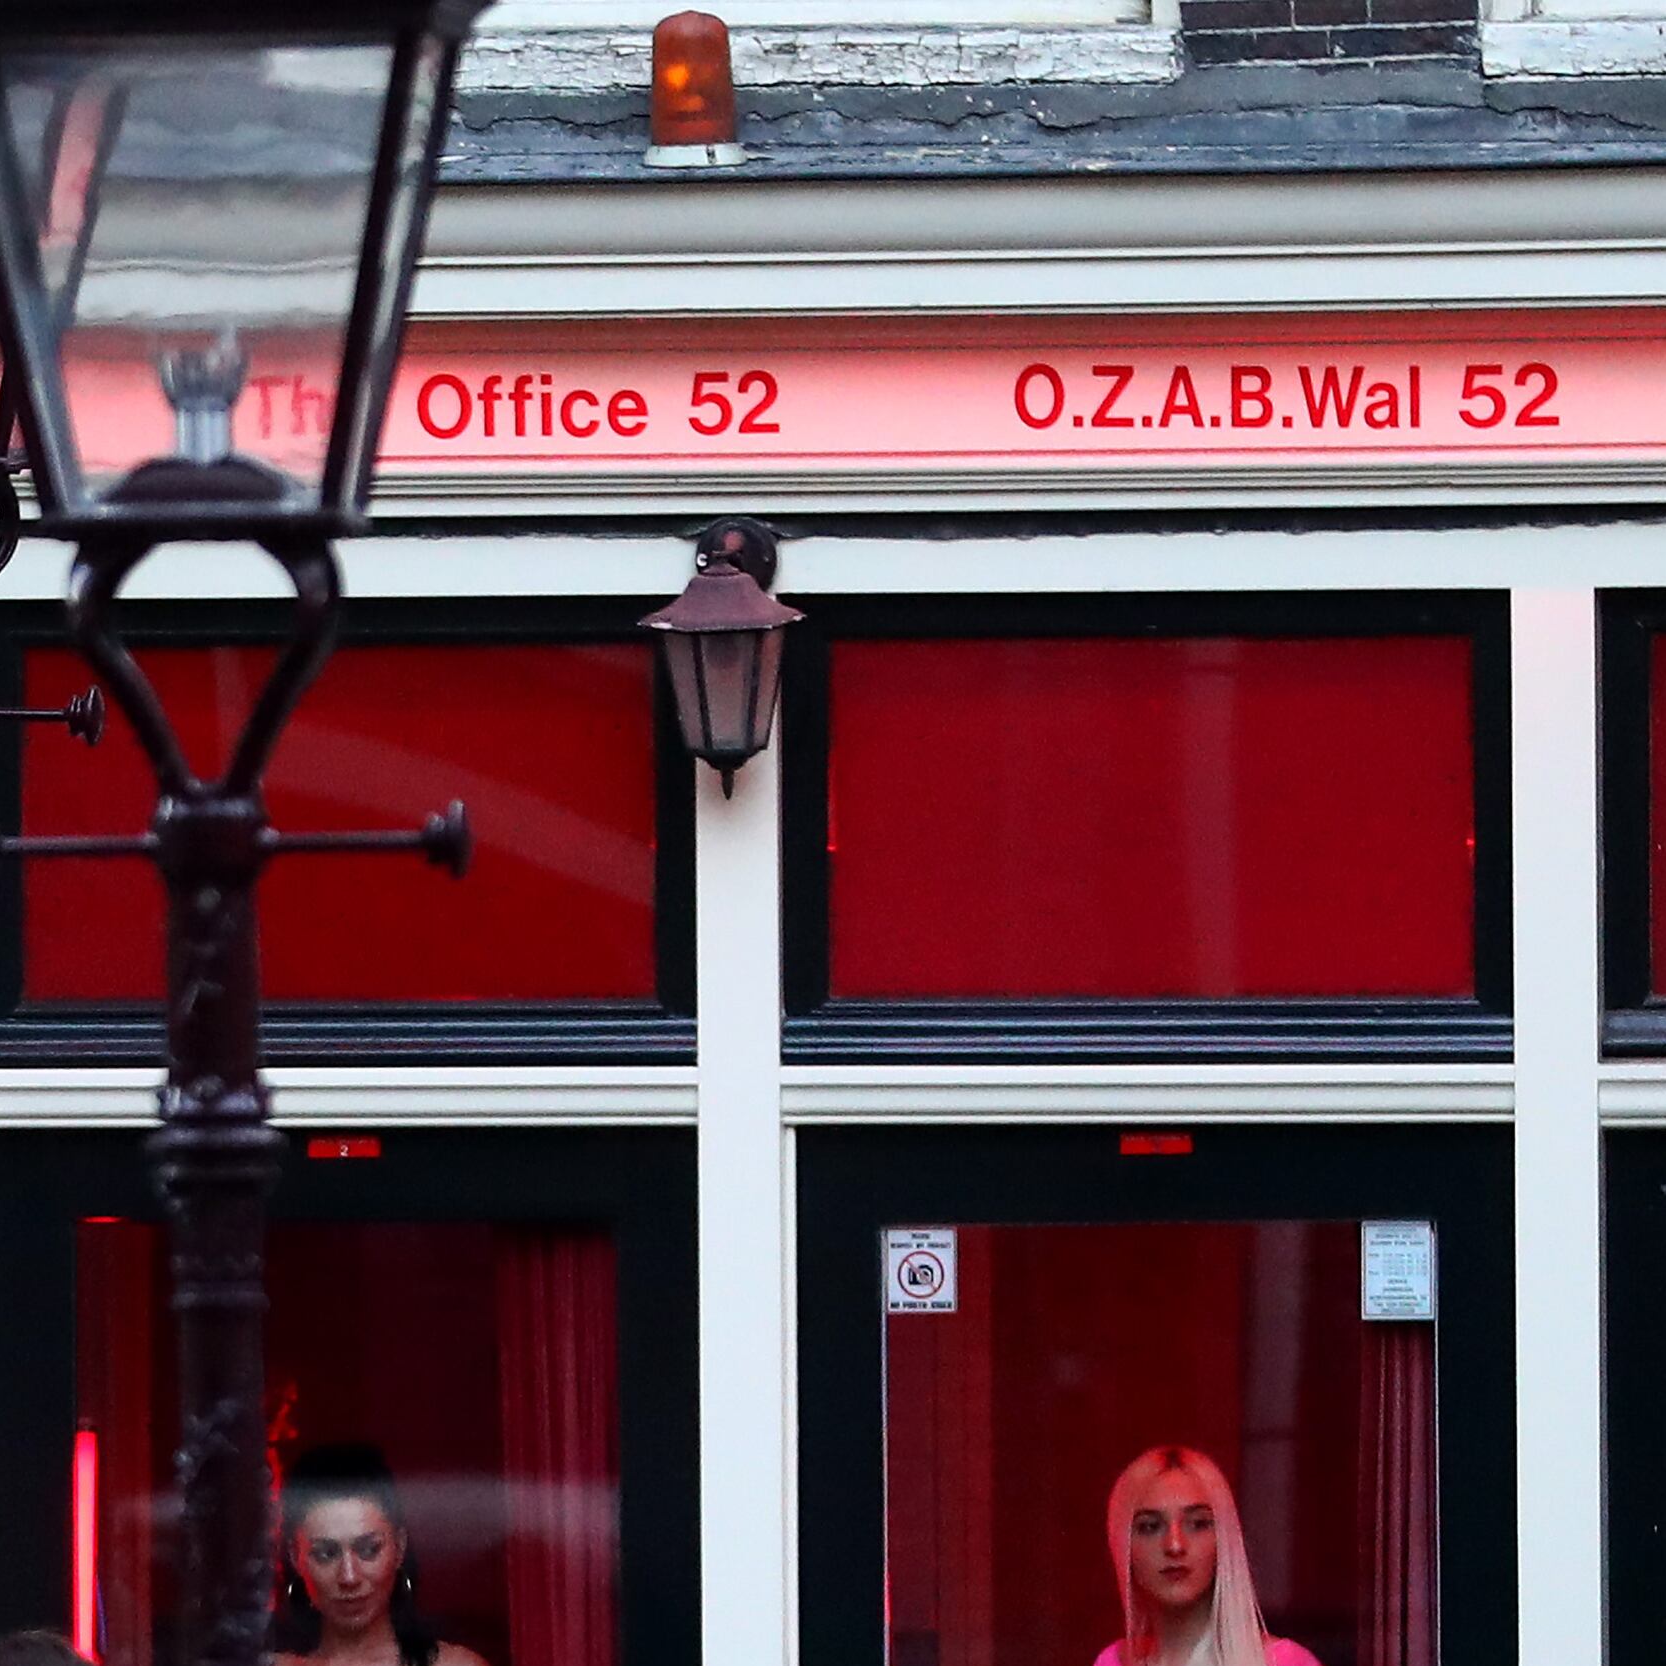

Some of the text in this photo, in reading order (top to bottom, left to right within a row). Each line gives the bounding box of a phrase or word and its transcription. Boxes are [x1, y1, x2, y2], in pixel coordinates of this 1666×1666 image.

[250, 368, 781, 440] Th Office 52
[1012, 362, 1561, 430] O.Z.A.B.Wal 52
